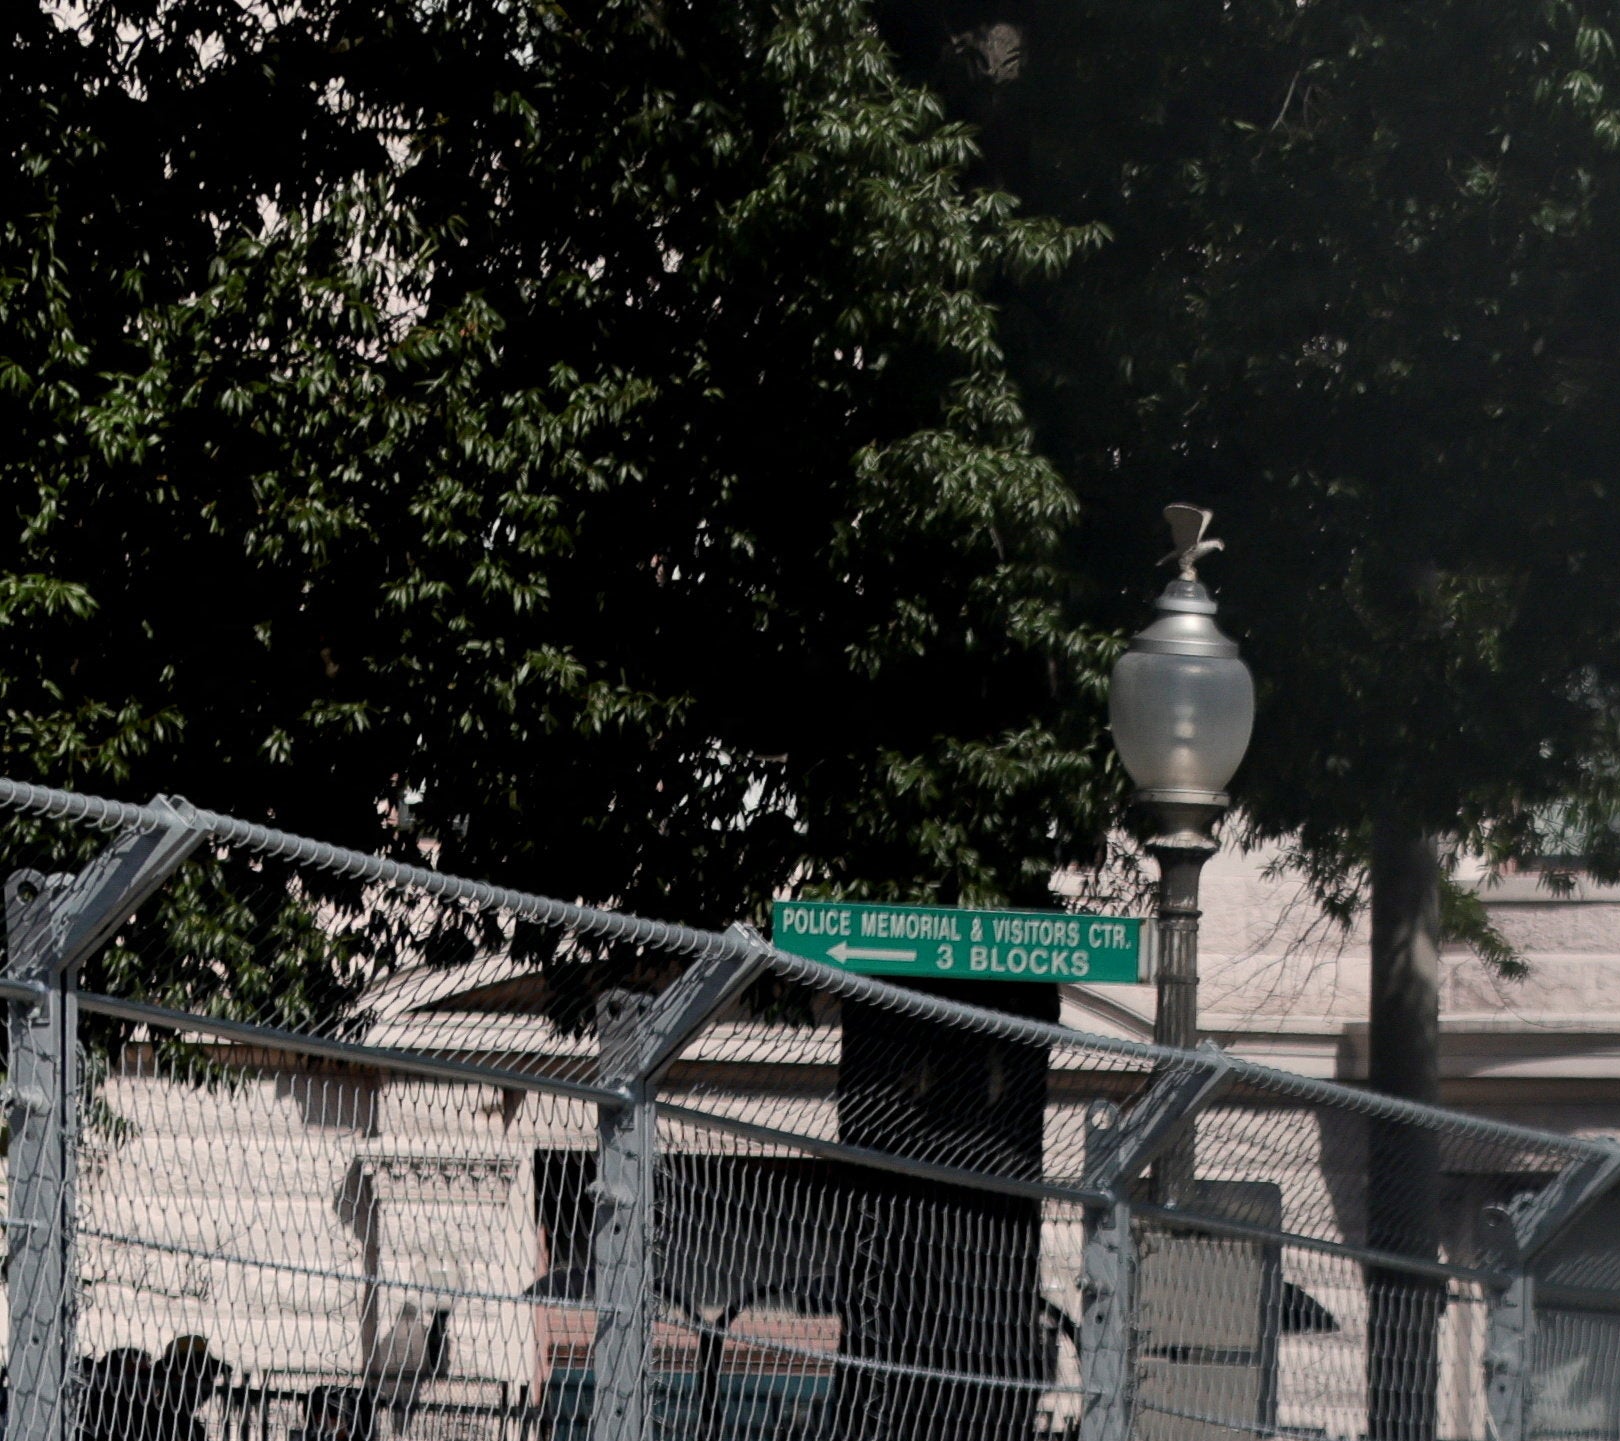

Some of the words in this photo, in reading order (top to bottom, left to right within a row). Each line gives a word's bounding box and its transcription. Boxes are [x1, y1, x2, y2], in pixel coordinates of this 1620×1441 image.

[783, 907, 851, 937] POLICE
[861, 912, 961, 943] MEMORIAL
[970, 917, 983, 942] &
[993, 918, 1080, 949] VISITORS
[1088, 923, 1132, 950] CTR.
[936, 946, 953, 971] 3
[970, 947, 1090, 977] BLOCKS
